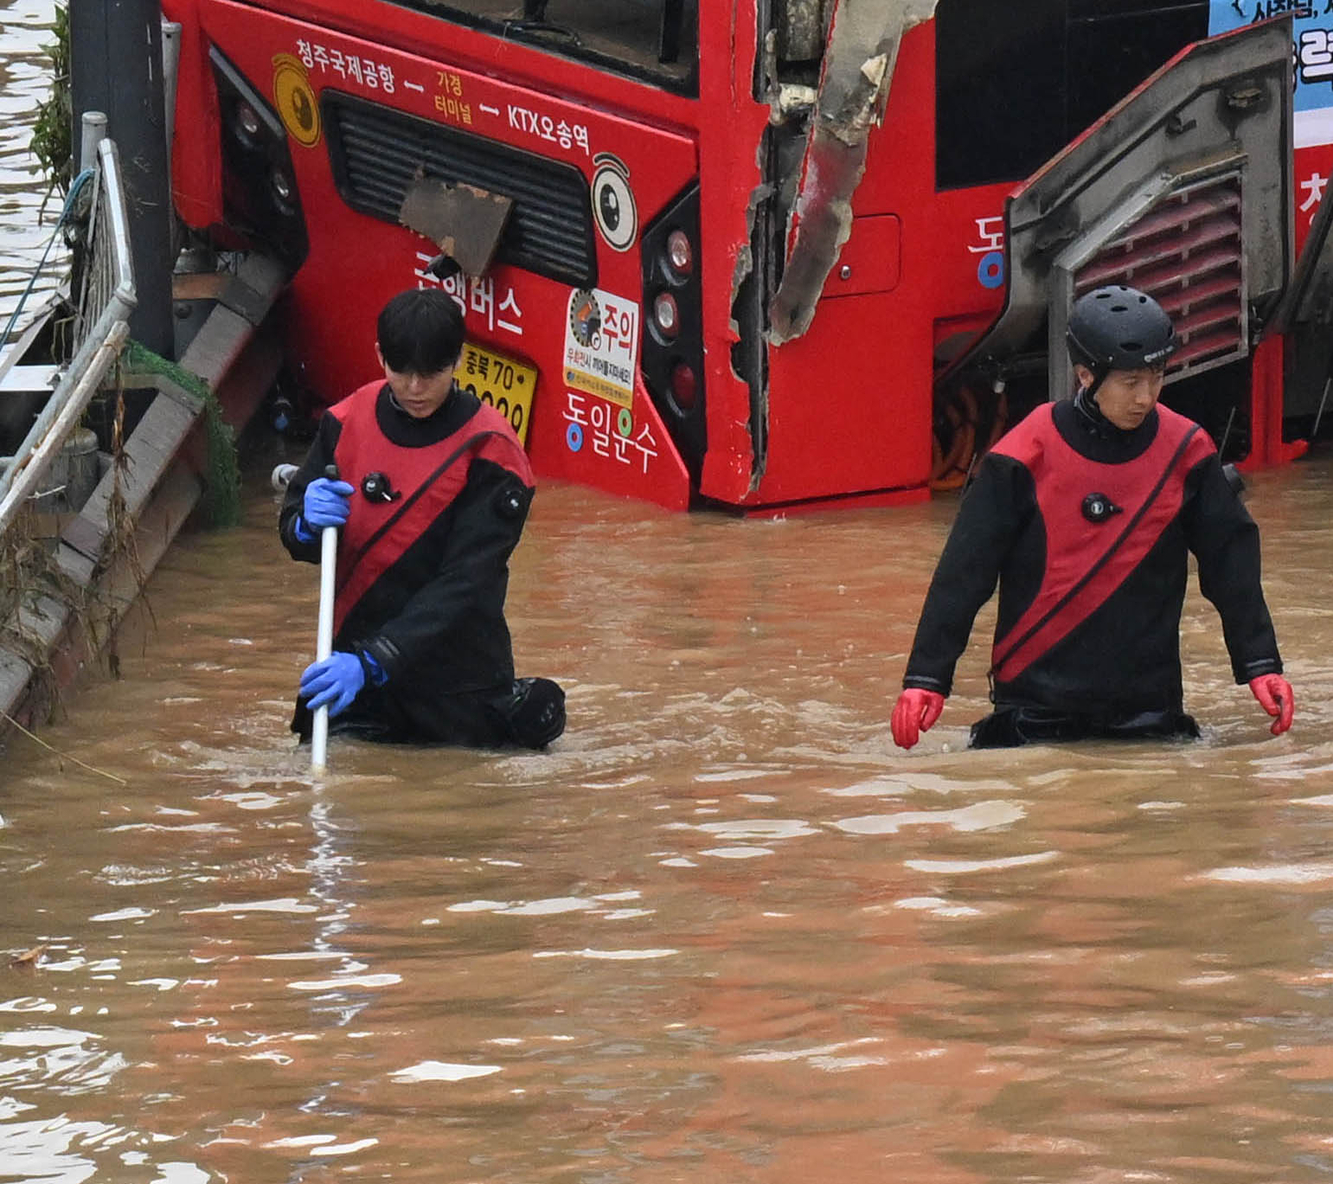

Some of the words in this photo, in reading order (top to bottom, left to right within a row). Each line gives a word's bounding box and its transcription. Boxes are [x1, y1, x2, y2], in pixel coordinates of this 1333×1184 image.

[297, 38, 395, 93] 청주국제공항
[437, 71, 462, 96] 가경
[434, 95, 472, 124] 터미널
[507, 104, 590, 156] KTX오송역
[603, 304, 634, 361] 주의
[494, 361, 513, 390] 70
[562, 393, 658, 474] 동일운수
